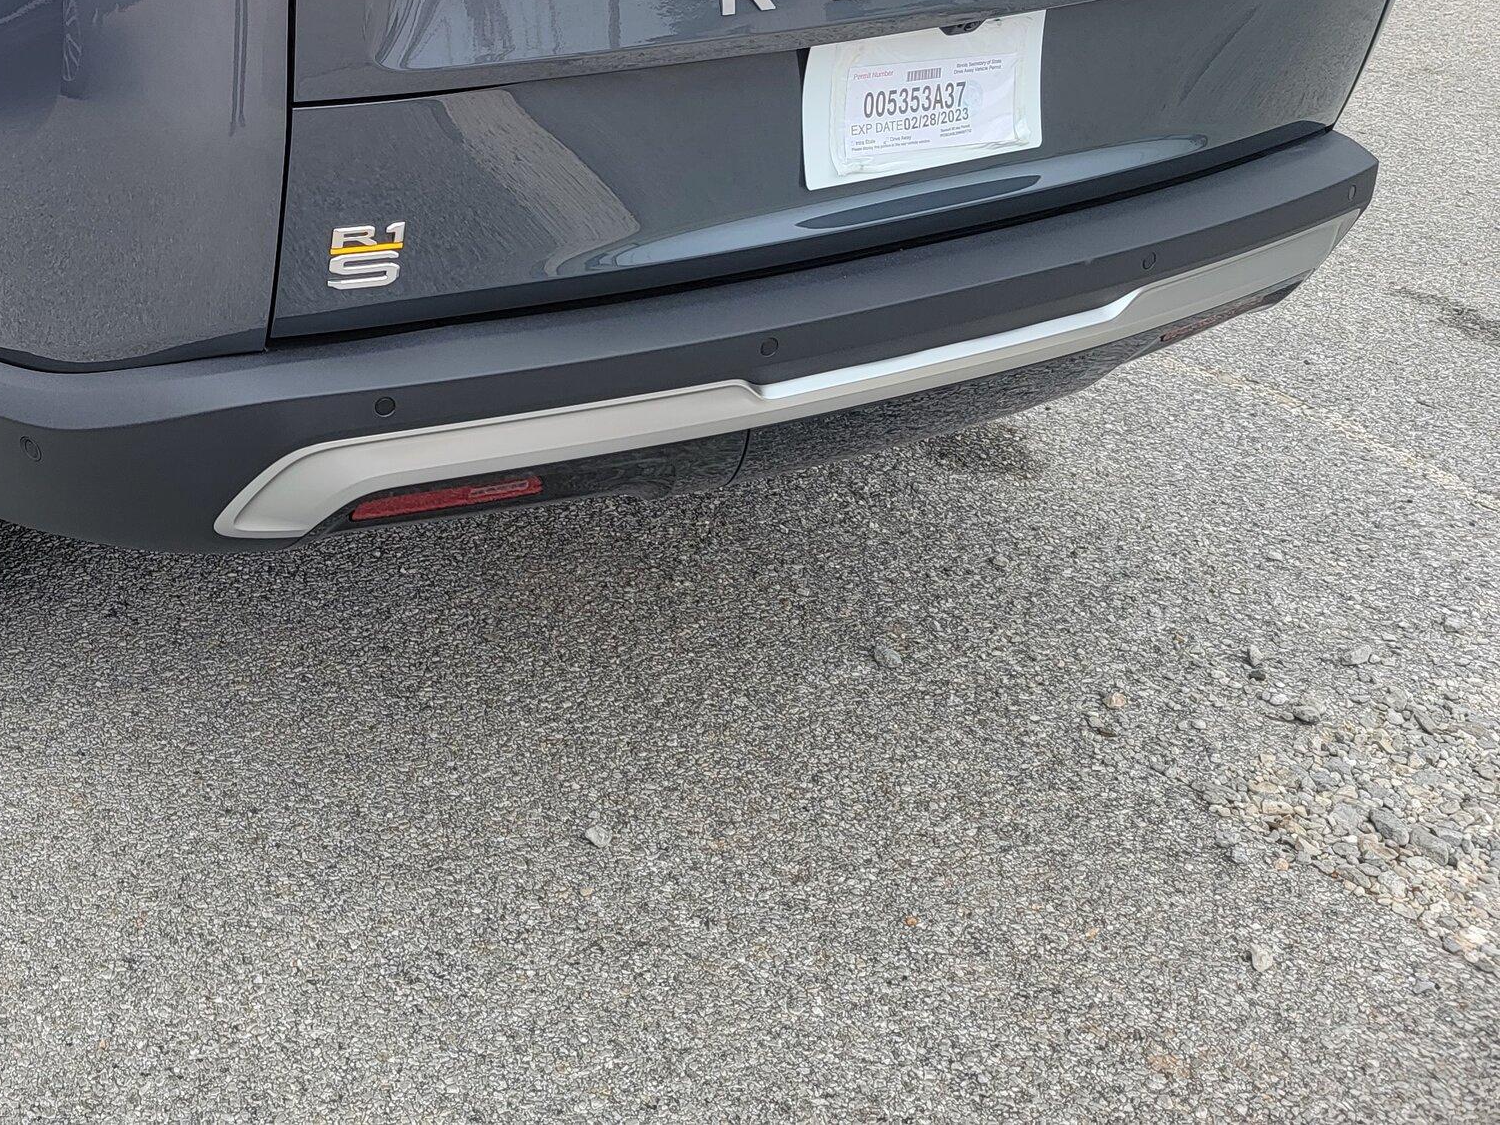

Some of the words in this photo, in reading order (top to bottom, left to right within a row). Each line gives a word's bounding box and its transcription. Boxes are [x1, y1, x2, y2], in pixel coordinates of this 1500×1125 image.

[872, 70, 894, 78] Number
[863, 81, 966, 118] 005353A37
[851, 123, 873, 136] EXP
[875, 120, 903, 134] DATE
[903, 107, 970, 131] 02/28/2023
[330, 221, 406, 249] R1
